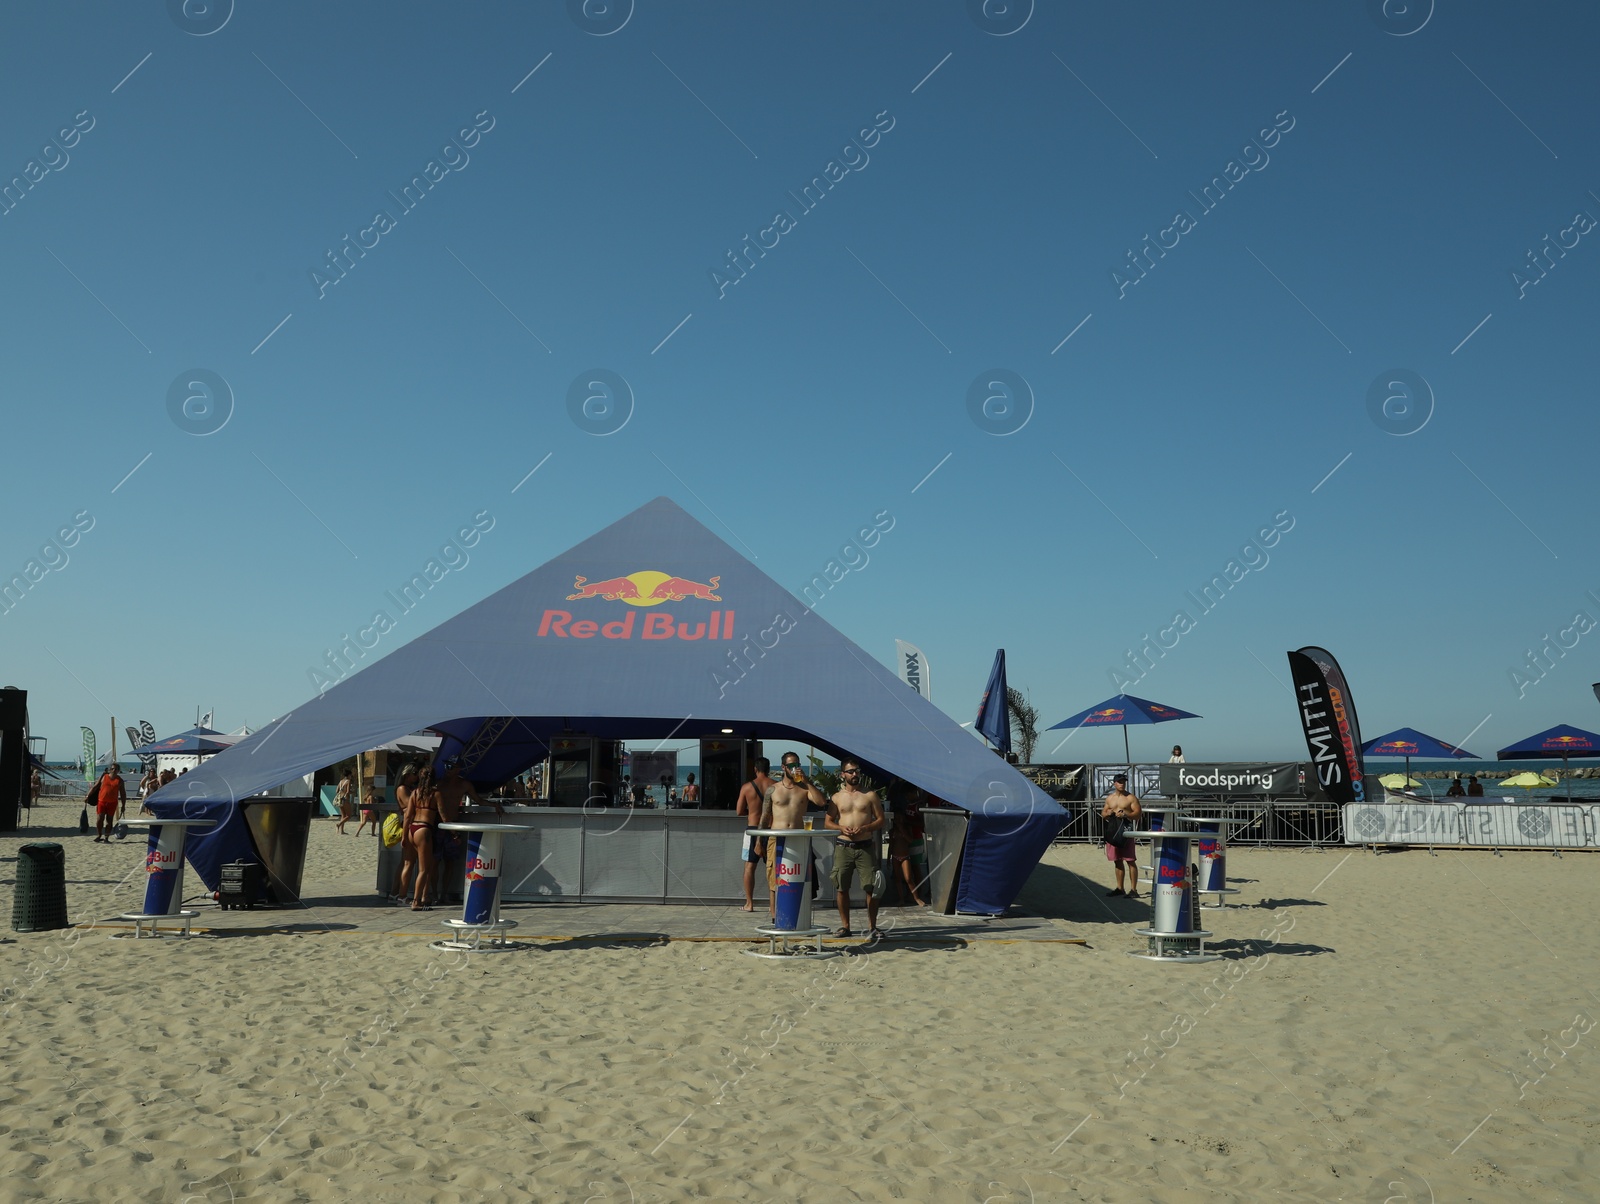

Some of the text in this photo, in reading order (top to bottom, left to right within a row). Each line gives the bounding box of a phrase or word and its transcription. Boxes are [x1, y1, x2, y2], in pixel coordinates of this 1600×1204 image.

[537, 610, 734, 640] Red Bull
[1299, 681, 1342, 787] SMITH
[1179, 768, 1273, 790] foodspring
[1199, 841, 1214, 851] Red
[153, 851, 176, 862] Bull
[475, 858, 496, 870] Bull
[779, 864, 801, 875] Bull
[1161, 865, 1185, 878] Red
